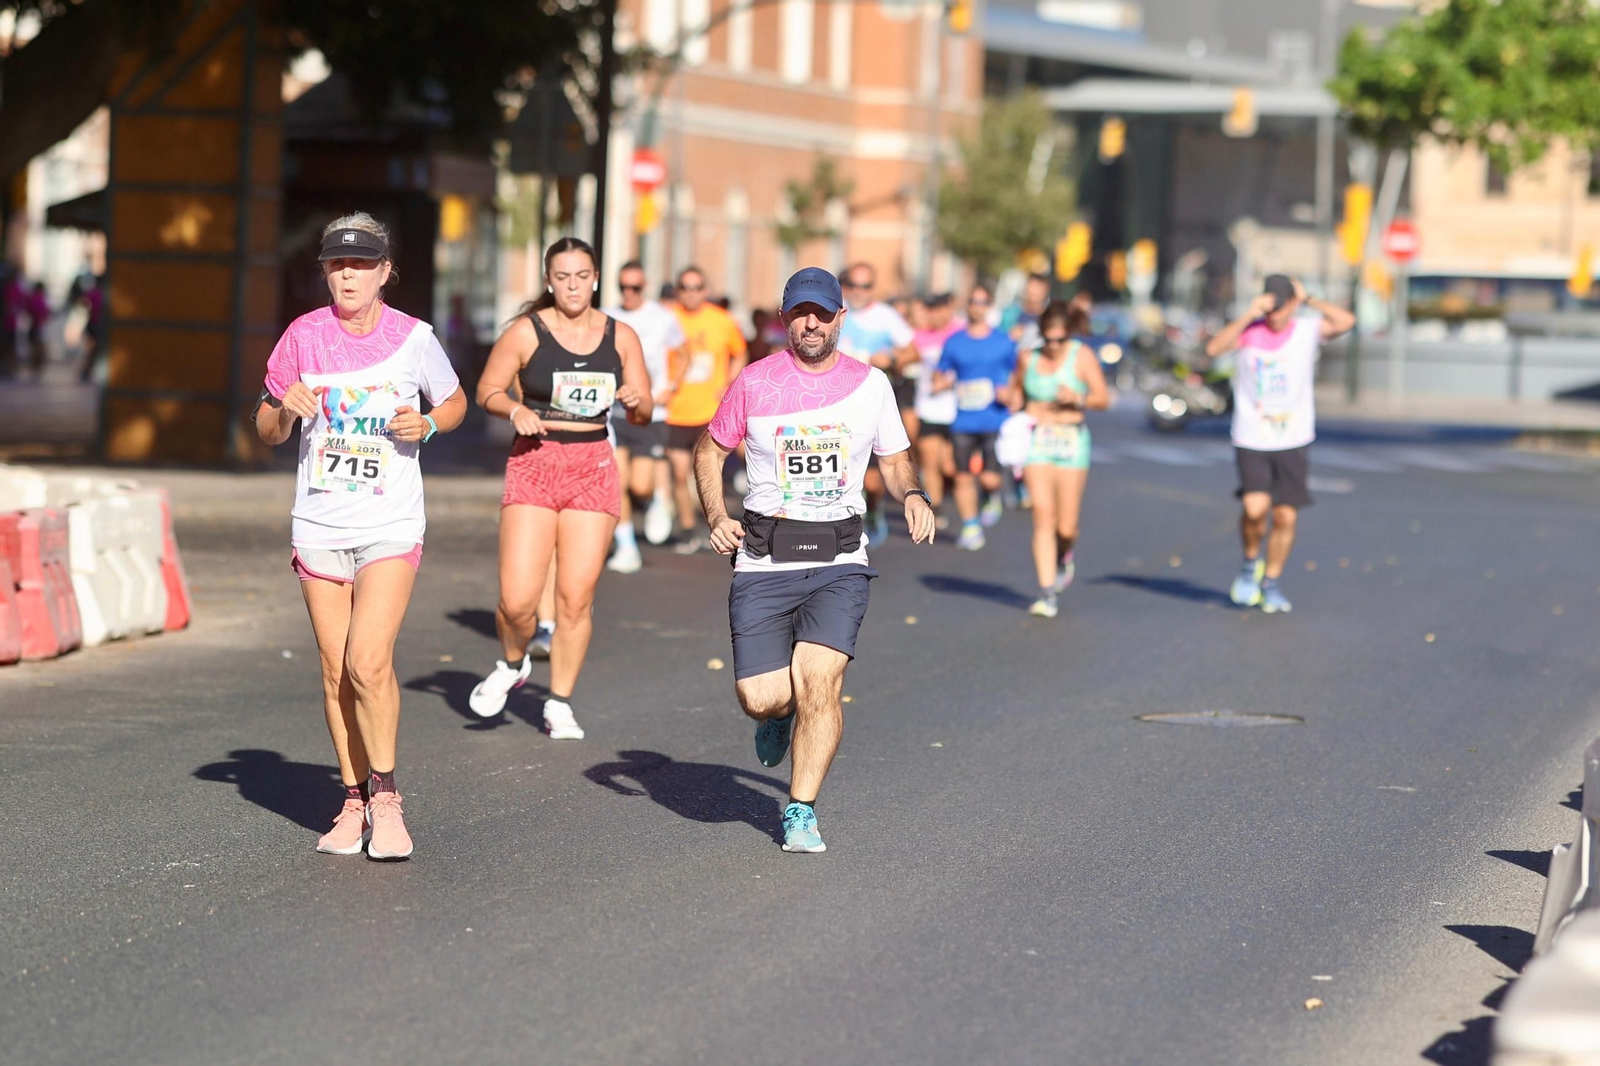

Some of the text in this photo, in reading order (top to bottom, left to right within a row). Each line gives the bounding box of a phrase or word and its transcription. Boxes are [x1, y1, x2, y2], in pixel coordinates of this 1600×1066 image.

[569, 388, 597, 403] 44
[545, 410, 573, 420] NIKE
[351, 417, 386, 436] XII
[324, 437, 346, 450] XII
[356, 445, 382, 455] 2025
[784, 439, 804, 451] XII
[816, 442, 840, 450] 2025
[325, 453, 380, 479] 715
[788, 454, 838, 475] 581
